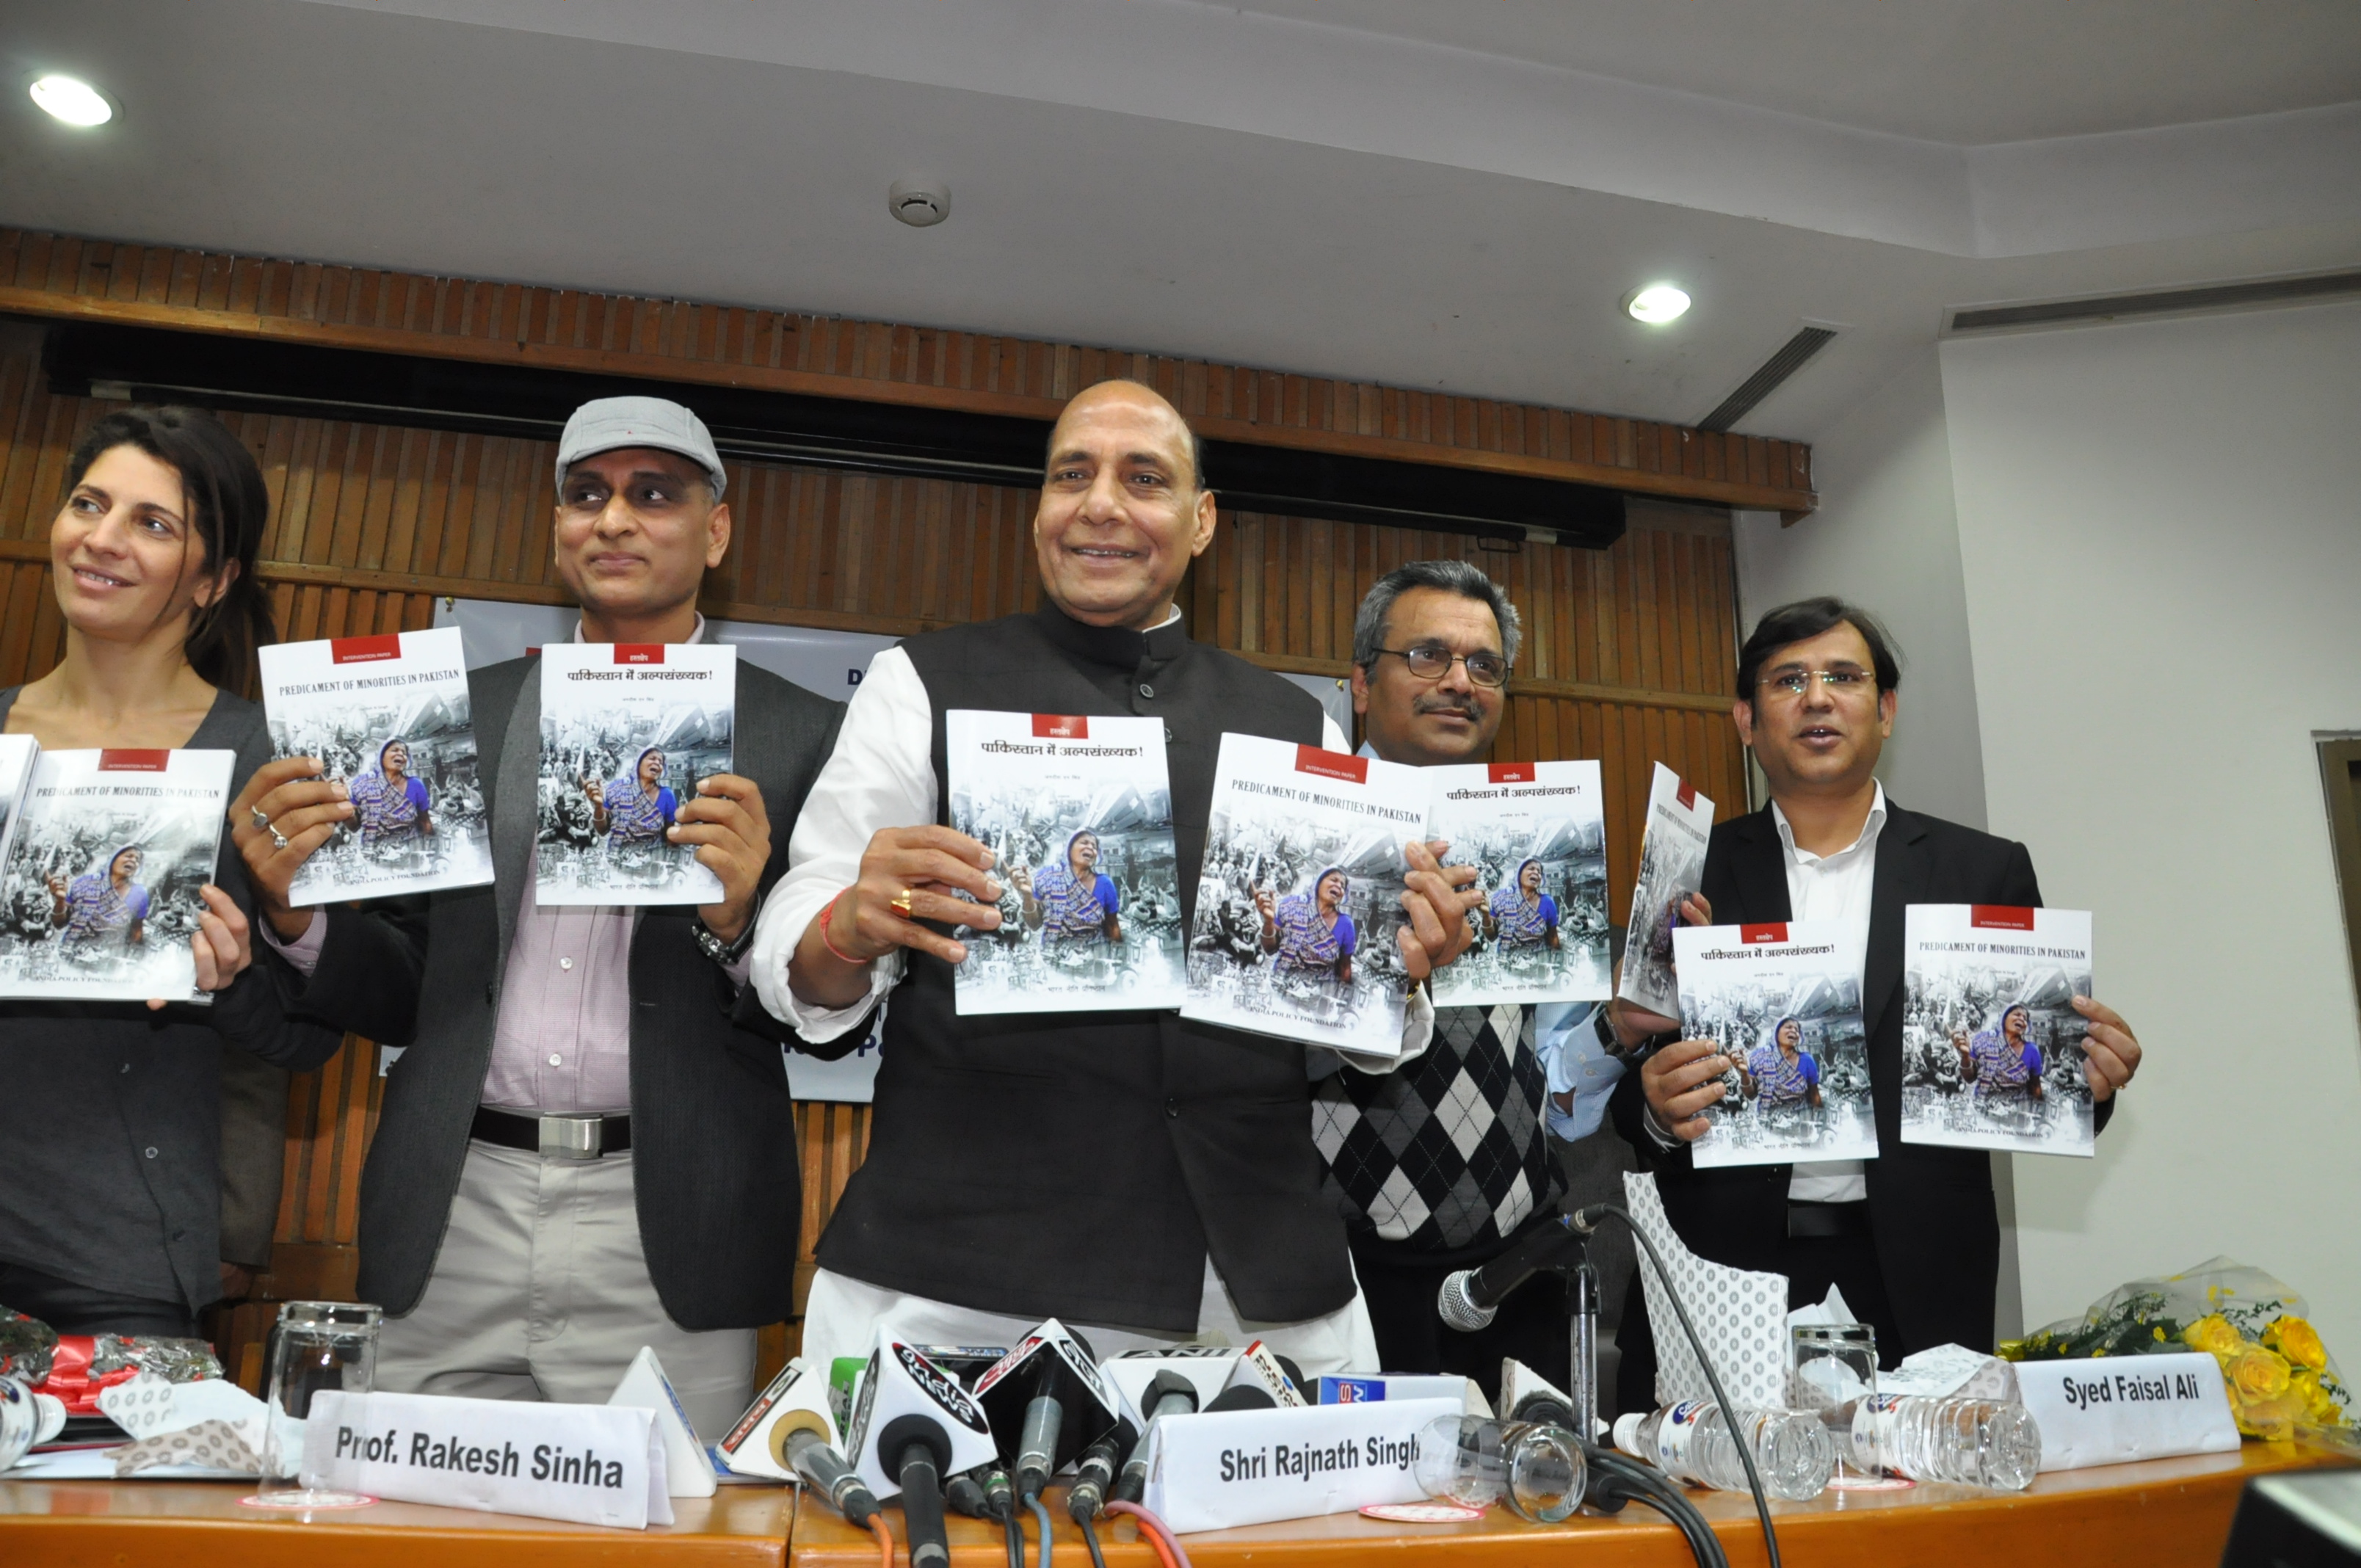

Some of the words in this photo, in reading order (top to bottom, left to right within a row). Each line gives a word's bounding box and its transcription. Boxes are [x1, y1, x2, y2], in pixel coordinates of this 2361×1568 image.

[280, 681, 340, 696] PREDICAMENT
[343, 680, 354, 690] OF
[357, 675, 406, 689] MINORITIES
[408, 675, 417, 683] IN
[419, 669, 459, 683] PAKISTAN
[567, 669, 623, 680] पाकिस्तान
[982, 740, 1043, 755] पाकिस्तान
[1305, 764, 1341, 777] INTERVENTION
[1341, 772, 1356, 780] PAPER
[36, 786, 97, 797] PREDICAMENT
[99, 786, 111, 796] OF
[112, 786, 164, 796] MINORITIES
[165, 788, 175, 796] IN
[177, 788, 220, 799] PAKISTAN
[1232, 779, 1297, 800] PREDICAMENT
[1299, 791, 1310, 802] OF
[1312, 794, 1366, 813] MINORITIES
[1367, 804, 1377, 816] IN
[1378, 806, 1421, 824] PAKISTAN
[1446, 788, 1498, 799] पाकिस्तान
[1701, 948, 1752, 960] पाकिस्तान
[1920, 942, 1976, 952] PREDICAMENT
[1978, 943, 1988, 953] OF
[1990, 944, 2036, 957] MINORITIES
[2037, 947, 2045, 957] IN
[2048, 948, 2086, 959] PAKISTAN
[1250, 1006, 1270, 1015] INDIA
[1271, 1011, 1297, 1020] POLICY
[1300, 1015, 1346, 1029] FOUNDATION
[1255, 1358, 1291, 1407] POIN
[1259, 1354, 1298, 1407] NEW
[2064, 1376, 2111, 1410] Syed
[2116, 1376, 2169, 1401] Faisal
[2177, 1375, 2199, 1398] Ali
[909, 1365, 971, 1423] NEWS
[336, 1426, 397, 1463] Prof.
[410, 1433, 518, 1476] Rakesh
[532, 1445, 623, 1488] Sinha
[1221, 1447, 1266, 1481] Shri
[1276, 1440, 1358, 1481] Rajnath
[1367, 1434, 1419, 1470] Singh
